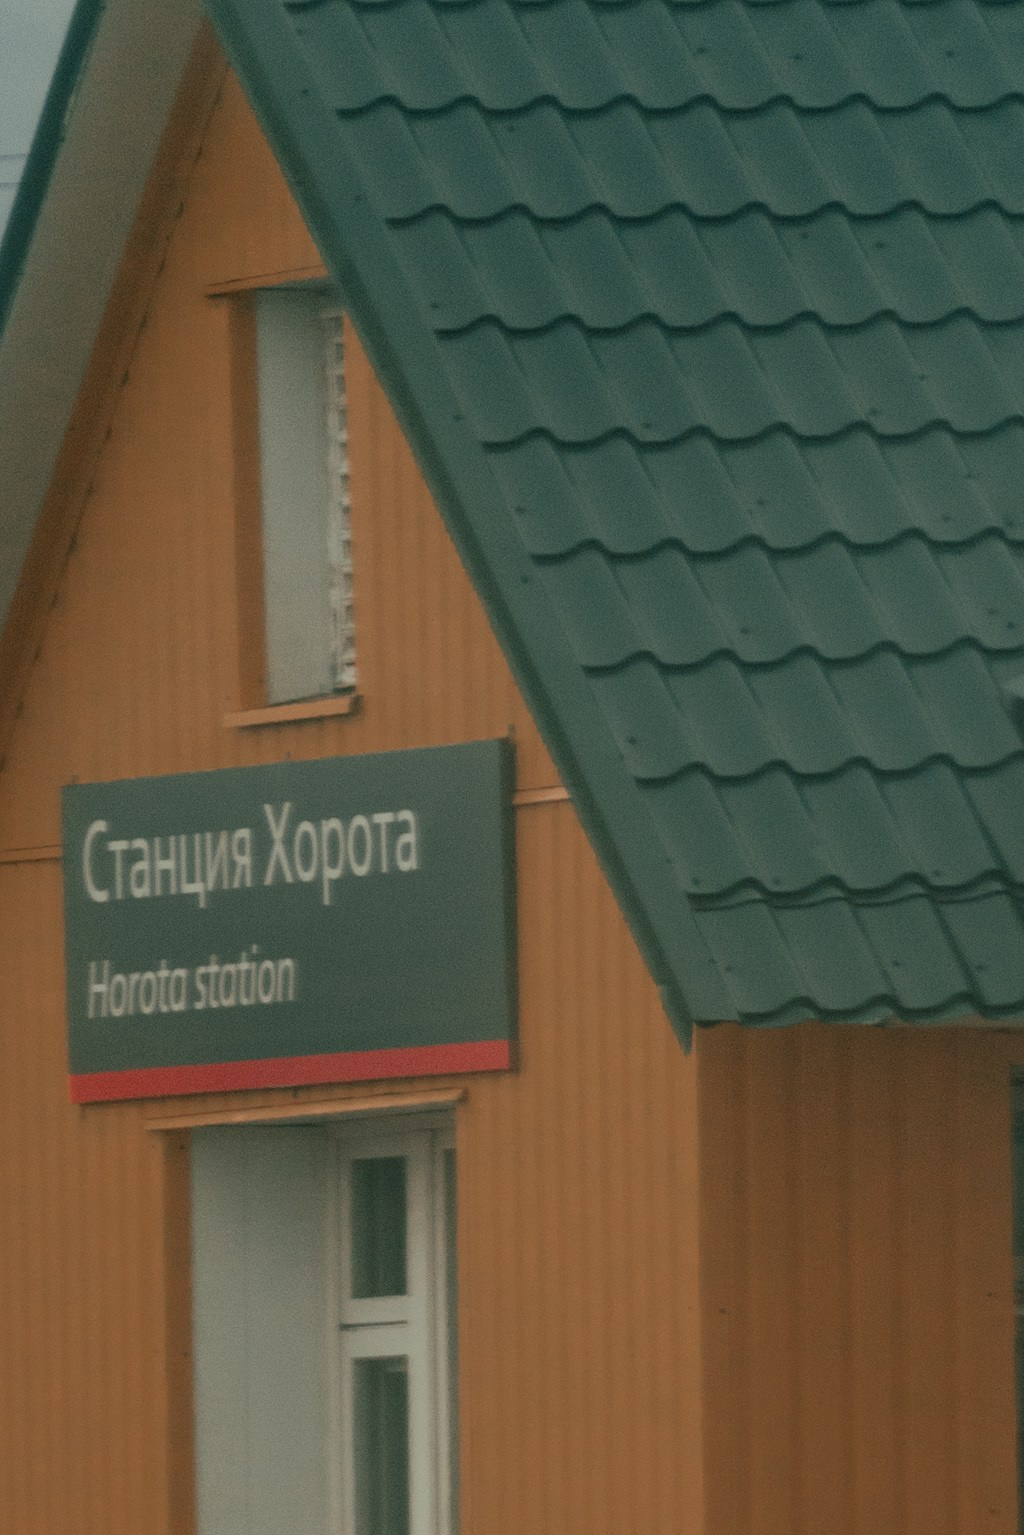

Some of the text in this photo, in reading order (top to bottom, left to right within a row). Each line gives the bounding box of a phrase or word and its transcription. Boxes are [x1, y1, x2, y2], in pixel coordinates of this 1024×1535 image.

[82, 802, 418, 907] Станция Хорота
[87, 945, 296, 1018] Horota station
